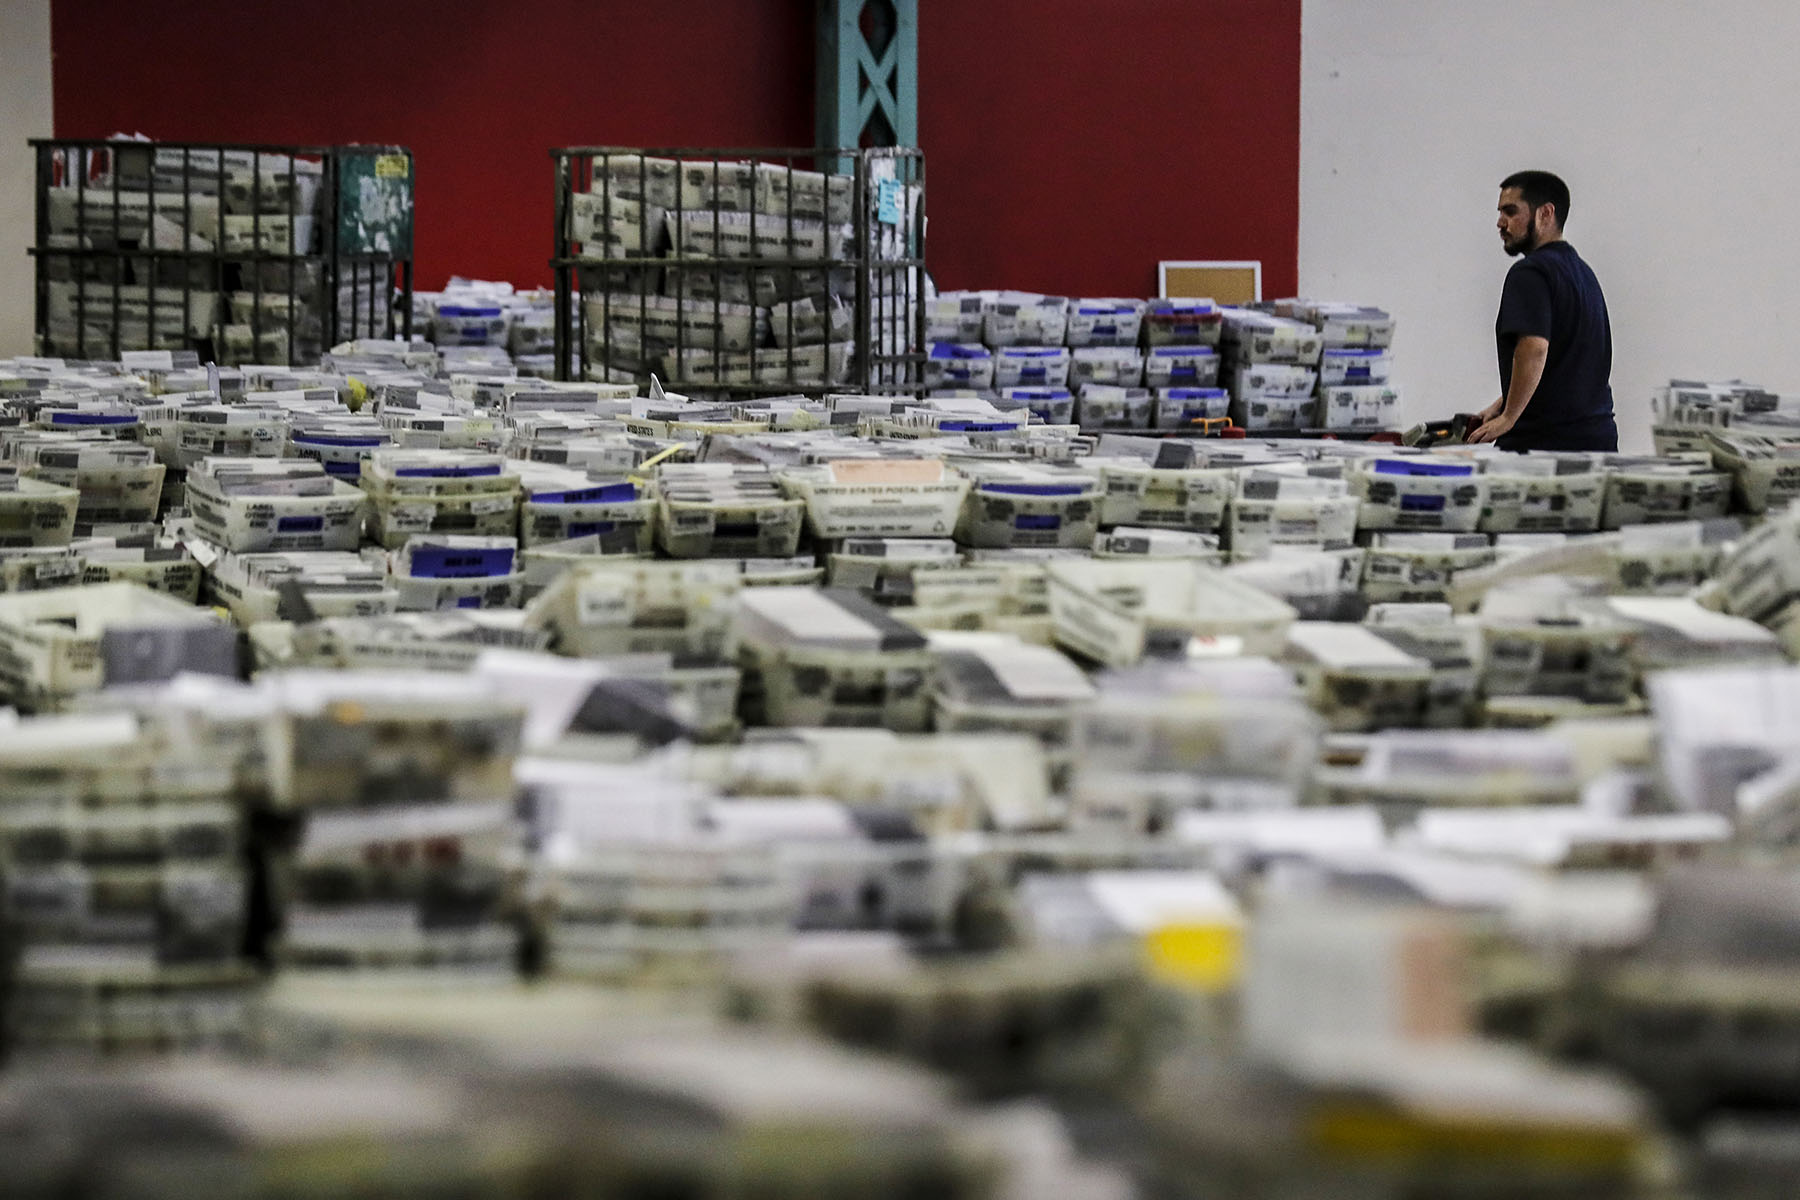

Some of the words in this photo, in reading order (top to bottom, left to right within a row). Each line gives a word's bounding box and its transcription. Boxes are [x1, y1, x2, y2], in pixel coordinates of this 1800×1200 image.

[691, 231, 717, 239] UNITE
[814, 487, 847, 496] UNITED
[850, 487, 883, 496] STATES
[885, 486, 918, 494] POSTAL
[922, 485, 959, 493] SERVICE
[246, 503, 274, 511] LABEL
[85, 566, 109, 575] ABEL
[82, 575, 111, 584] THER
